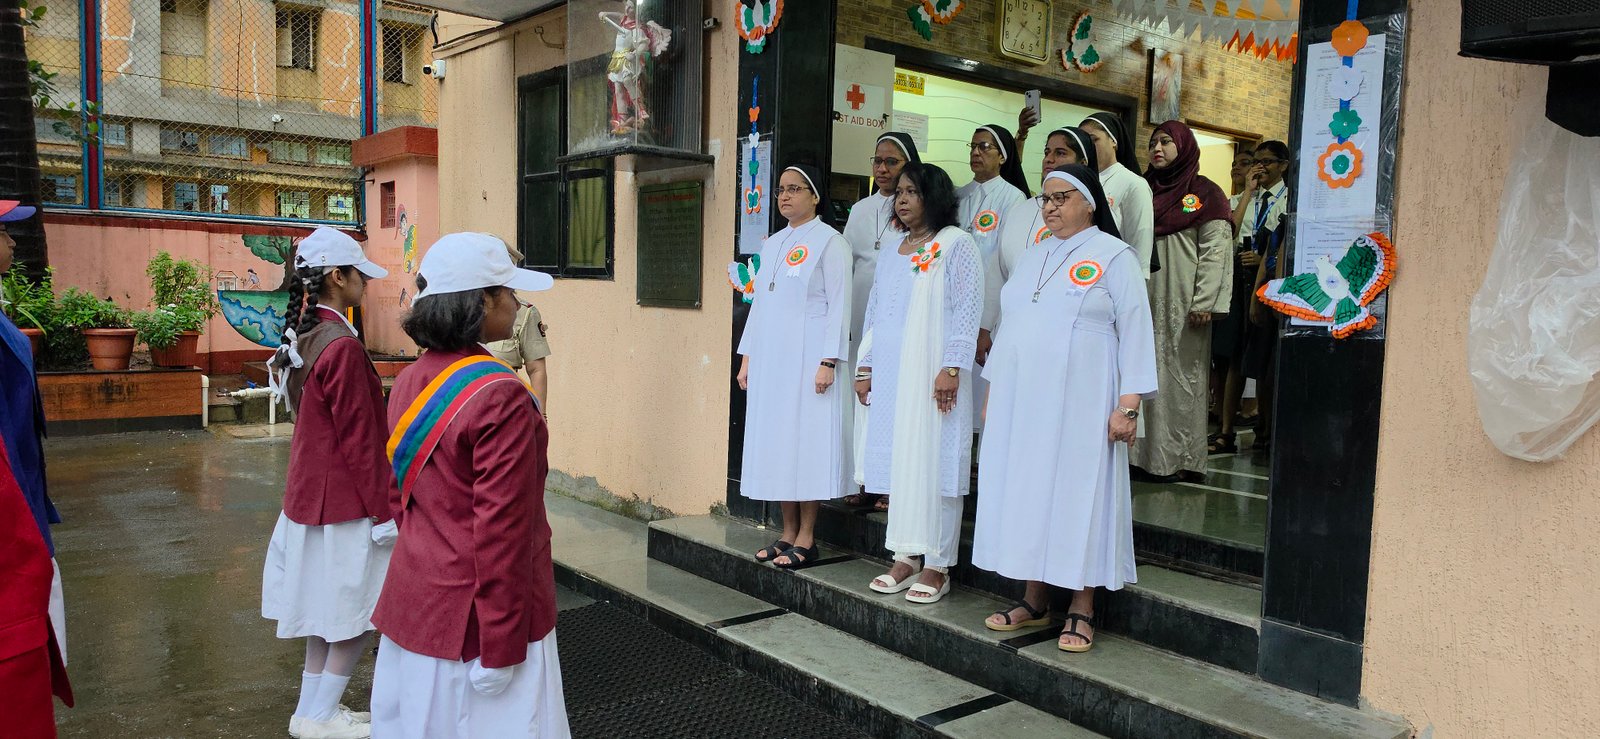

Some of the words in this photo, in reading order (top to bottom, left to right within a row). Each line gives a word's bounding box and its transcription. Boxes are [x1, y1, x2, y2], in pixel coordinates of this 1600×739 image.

[1007, 3, 1013, 12] 10
[1022, 1, 1028, 10] 12
[851, 115, 865, 125] AID
[866, 118, 884, 128] BOX
